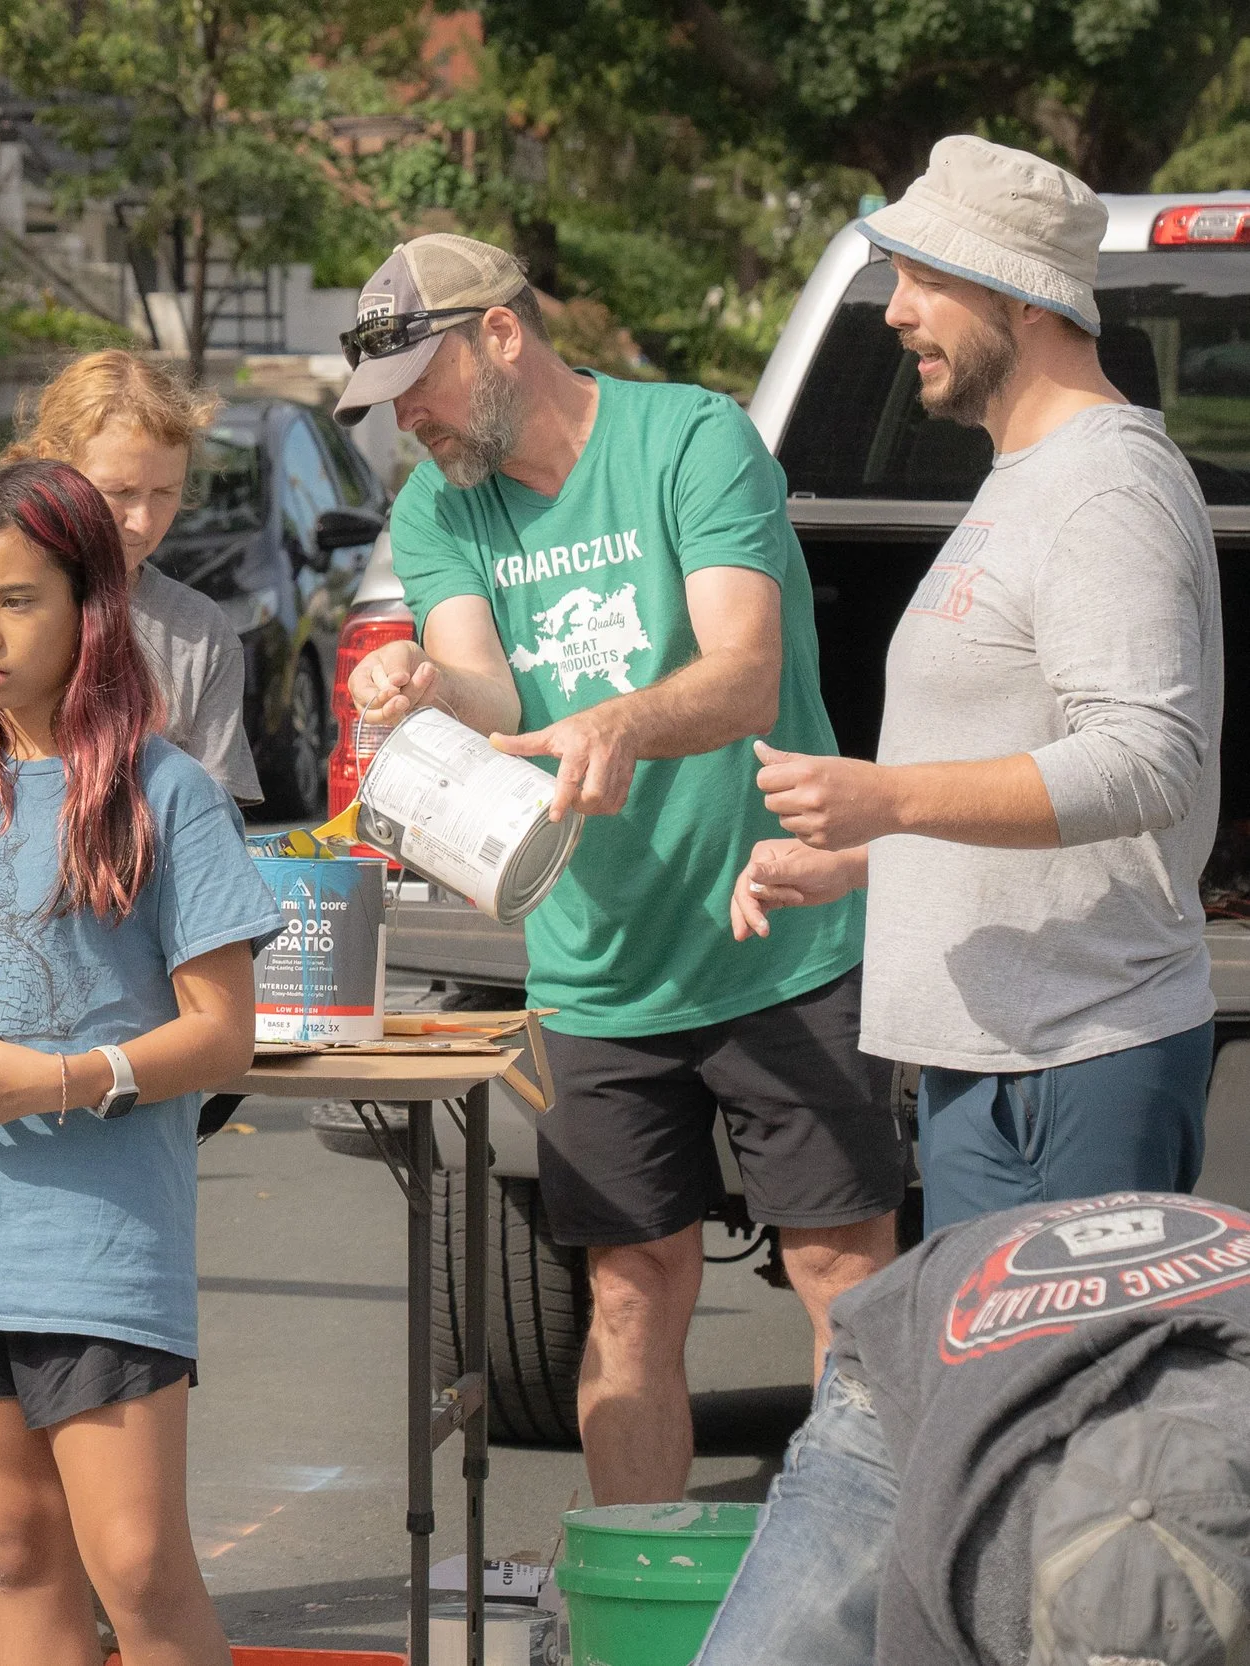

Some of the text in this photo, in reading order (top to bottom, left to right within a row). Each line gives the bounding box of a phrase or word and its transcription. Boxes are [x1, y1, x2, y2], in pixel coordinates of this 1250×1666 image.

[587, 612, 625, 632] Quality
[562, 638, 598, 657] MEAT
[308, 898, 348, 911] Moore
[283, 918, 332, 935] OOR
[328, 1024, 340, 1032] 3X
[1118, 1233, 1250, 1297] PPLING
[968, 1276, 1107, 1335] GOLIATH
[502, 1561, 514, 1586] CHIP
